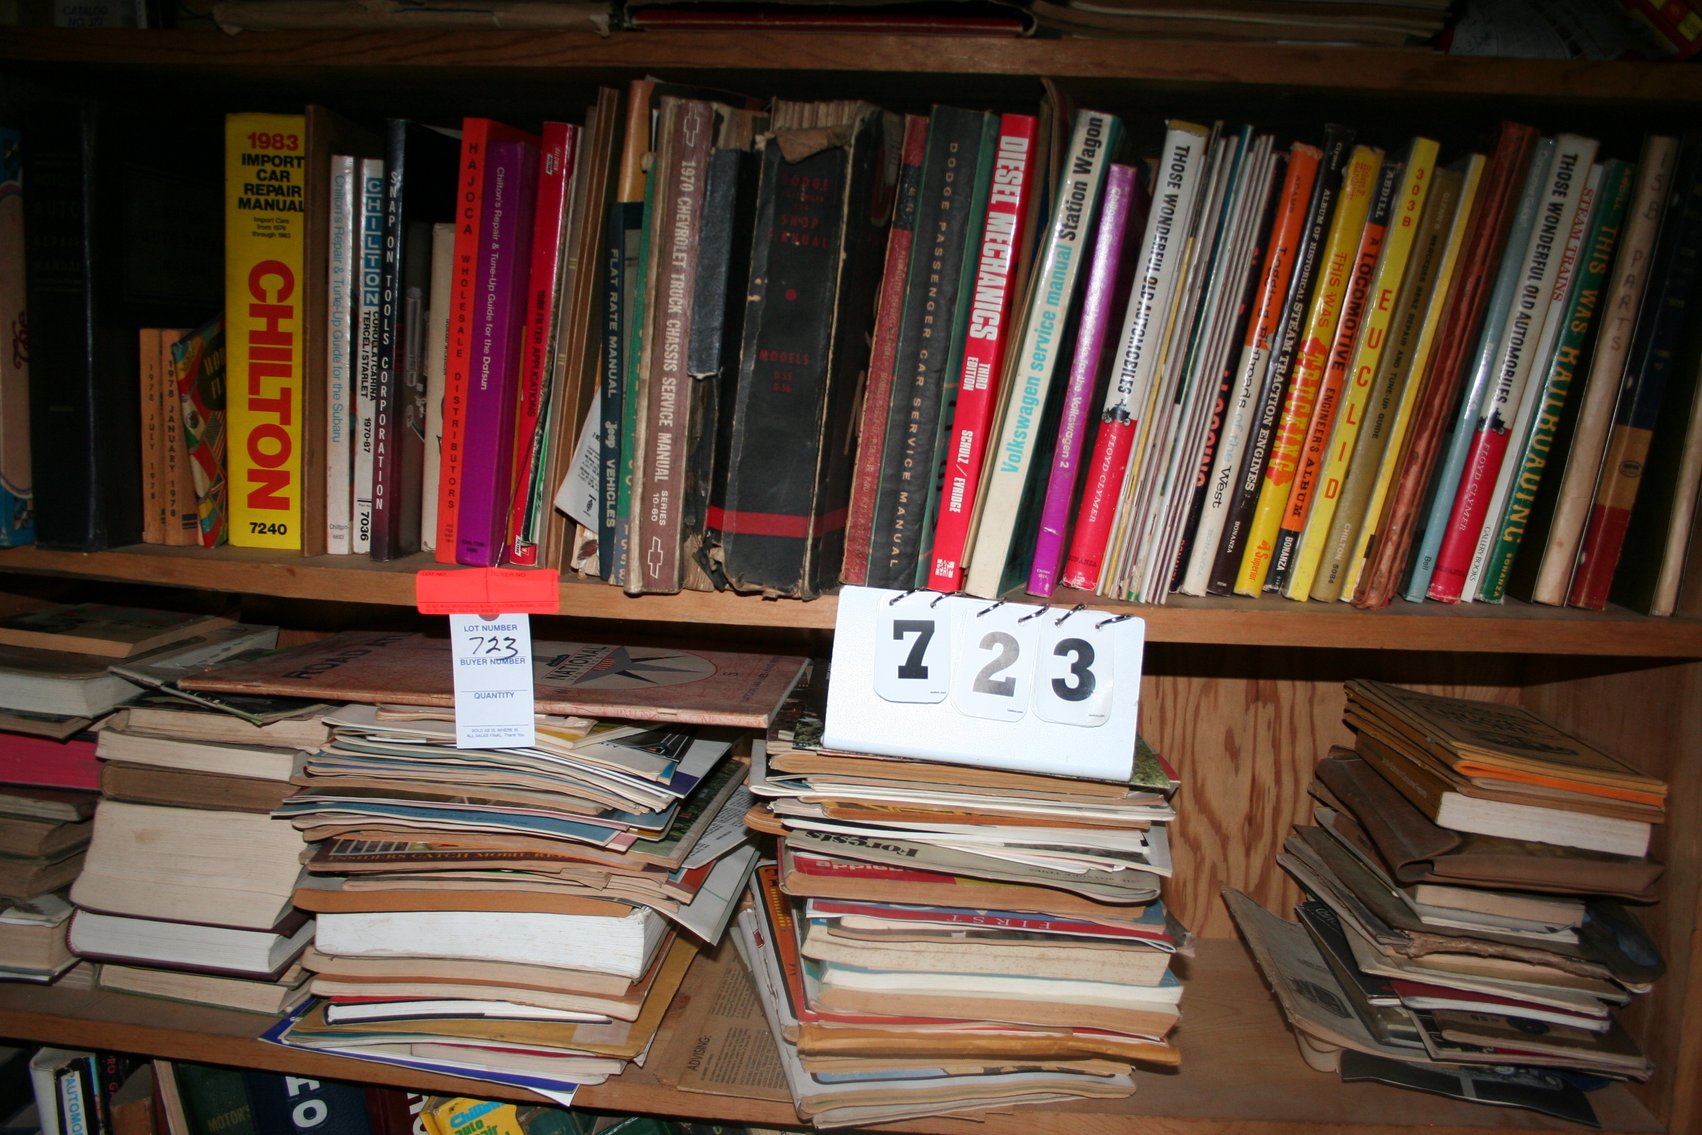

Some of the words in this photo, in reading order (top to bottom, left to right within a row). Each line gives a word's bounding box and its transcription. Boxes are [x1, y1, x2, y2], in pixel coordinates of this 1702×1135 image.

[241, 153, 304, 168] IMPORT
[247, 132, 299, 151] 1983
[1072, 115, 1104, 176] Wagon
[256, 169, 290, 183] CAR
[464, 142, 479, 234] HAJOCA
[495, 166, 505, 208] Chilton's
[680, 161, 697, 193] 1970
[941, 142, 959, 211] DODGE
[990, 135, 1030, 205] DIESEL
[1166, 145, 1191, 190] THOSE
[1551, 153, 1579, 198] THOSE
[238, 197, 304, 212] MANUAL
[244, 183, 302, 197] REPAIR
[388, 171, 400, 228] SNAP
[1315, 188, 1331, 224] ALBUM
[1375, 168, 1395, 219] ABDILL
[491, 209, 503, 240] Repair
[1058, 182, 1088, 242] Station
[1567, 186, 1595, 240] STEAM
[333, 223, 345, 265] Repair
[366, 180, 381, 306] CHILTON
[386, 236, 395, 264] ON
[672, 197, 694, 269] CHEVROLET
[1150, 193, 1179, 273] WONDERFUL
[1312, 225, 1322, 241] OF
[1368, 236, 1380, 247] A
[1524, 200, 1566, 284] WONDERFUL
[1588, 222, 1620, 274] THIS
[488, 253, 499, 290] Tune-Up
[608, 248, 620, 286] FLAT
[922, 221, 948, 338] PASSENGER
[968, 211, 1018, 341] MECHANICS
[1045, 242, 1073, 308] manual
[1298, 241, 1320, 300] HISTORICAL
[1328, 251, 1348, 288] THIS
[1418, 234, 1438, 284] MERCEDES
[1550, 245, 1579, 303] TRAINS
[668, 272, 687, 314] TRUCK
[1140, 275, 1158, 300] OLD
[1257, 246, 1288, 318] Logging
[1410, 285, 1423, 311] BENZ
[1517, 285, 1541, 311] OLD
[332, 278, 345, 328] Tune-Up
[383, 275, 393, 345] TOOLS
[456, 255, 472, 358] WHOLESALE
[486, 293, 497, 322] Guide
[607, 290, 619, 331] RATE
[1318, 292, 1337, 329] WAS
[1330, 251, 1377, 373] LOCOMOTIVE
[1569, 287, 1601, 335] WAS
[332, 329, 346, 362] Guide
[483, 339, 493, 354] the
[484, 322, 494, 336] for
[532, 312, 544, 344] FILTER
[663, 319, 681, 372] CHASSIS
[1030, 311, 1057, 372] service
[1281, 301, 1306, 351] STEAM
[1399, 312, 1414, 347] REPAIR
[332, 365, 345, 379] for
[480, 356, 491, 391] Datsun
[607, 336, 619, 399] MANUAL
[759, 348, 811, 368] MODELS
[915, 350, 929, 387] CAR
[962, 356, 980, 391] EDITION
[975, 362, 992, 391] THIRD
[1238, 323, 1273, 409] Railroads
[1392, 348, 1404, 369] AND
[1495, 311, 1534, 404] AUTOMOBILES
[168, 361, 177, 398] 1978
[246, 259, 295, 511] CHILTON
[332, 383, 345, 400] the
[527, 346, 541, 417] APPLICATIONS
[1262, 353, 1290, 428] TRACTION
[1323, 287, 1394, 500] EUCLID
[1380, 370, 1397, 410] TUNE-UP
[658, 376, 677, 427] SERVICE
[1277, 350, 1324, 474] TRUCKING
[1310, 387, 1337, 453] ENGINEER'S
[168, 405, 177, 474] JANUARY
[332, 402, 344, 443] Subaru
[363, 417, 372, 454] 1970-87
[375, 357, 389, 510] CORPORATION
[448, 372, 462, 509] DISTRIBUTORS
[604, 421, 618, 450] Jeep
[901, 396, 922, 481] SERVICE
[1000, 374, 1041, 473] Volkswagen
[1060, 396, 1083, 460] Volkswagen
[1371, 412, 1385, 440] GUIDE
[654, 432, 673, 483] MANUAL
[956, 429, 974, 465] SCHULZ
[1059, 460, 1069, 469] 2
[1103, 433, 1118, 471] FLOYD
[1225, 432, 1240, 463] the
[1244, 428, 1272, 493] ENGINES
[1474, 442, 1492, 484] FLOYD
[1502, 345, 1585, 546] RAILROADING
[605, 459, 617, 528] VEHICLES
[949, 476, 966, 514] EVRIDGE
[1088, 476, 1106, 523] CLYMER
[1212, 465, 1232, 509] West
[1291, 455, 1315, 518] ALBUM
[249, 522, 287, 535] 7240
[360, 511, 370, 541] 7036
[659, 490, 669, 527] SERIES
[1459, 485, 1481, 532] CLYMER
[889, 491, 909, 568] MANUAL
[1226, 521, 1241, 554] BONANZA
[1335, 522, 1352, 561] CHILTON
[1478, 526, 1492, 556] GALLERY
[1248, 549, 1269, 582] Superior
[1276, 536, 1295, 571] BONANZA
[1468, 557, 1483, 583] BOOKS
[1493, 551, 1514, 599] BONANZA
[468, 635, 519, 661] 723
[481, 624, 518, 632] NUMBER
[460, 658, 488, 666] BUYER
[490, 657, 526, 666] NUMBER
[545, 646, 609, 681] NATIONAL
[474, 691, 515, 700] QUANTITY
[804, 829, 920, 859] Forests
[946, 913, 1051, 930] FIRST
[687, 1034, 712, 1072] ADVISING:
